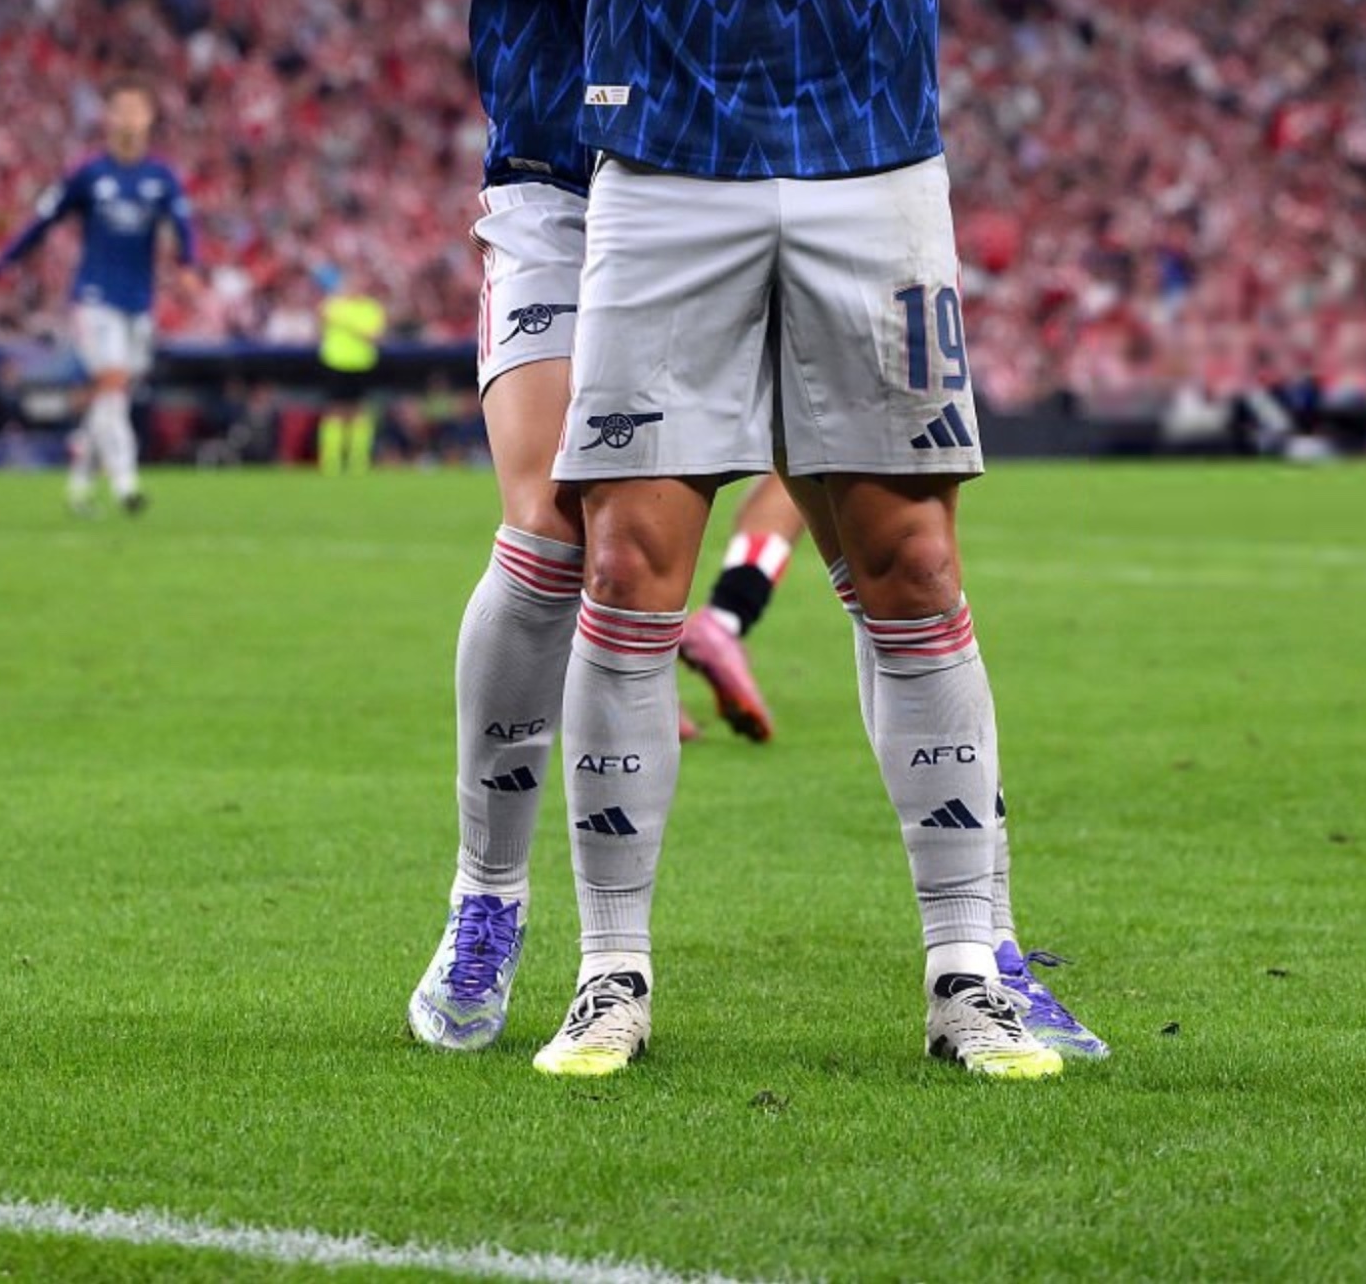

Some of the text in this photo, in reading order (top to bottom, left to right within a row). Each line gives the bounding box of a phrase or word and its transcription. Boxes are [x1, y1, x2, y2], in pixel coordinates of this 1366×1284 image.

[893, 283, 968, 391] 19
[484, 718, 546, 740] AFC
[575, 753, 642, 775] AFC
[909, 743, 977, 768] AFC
